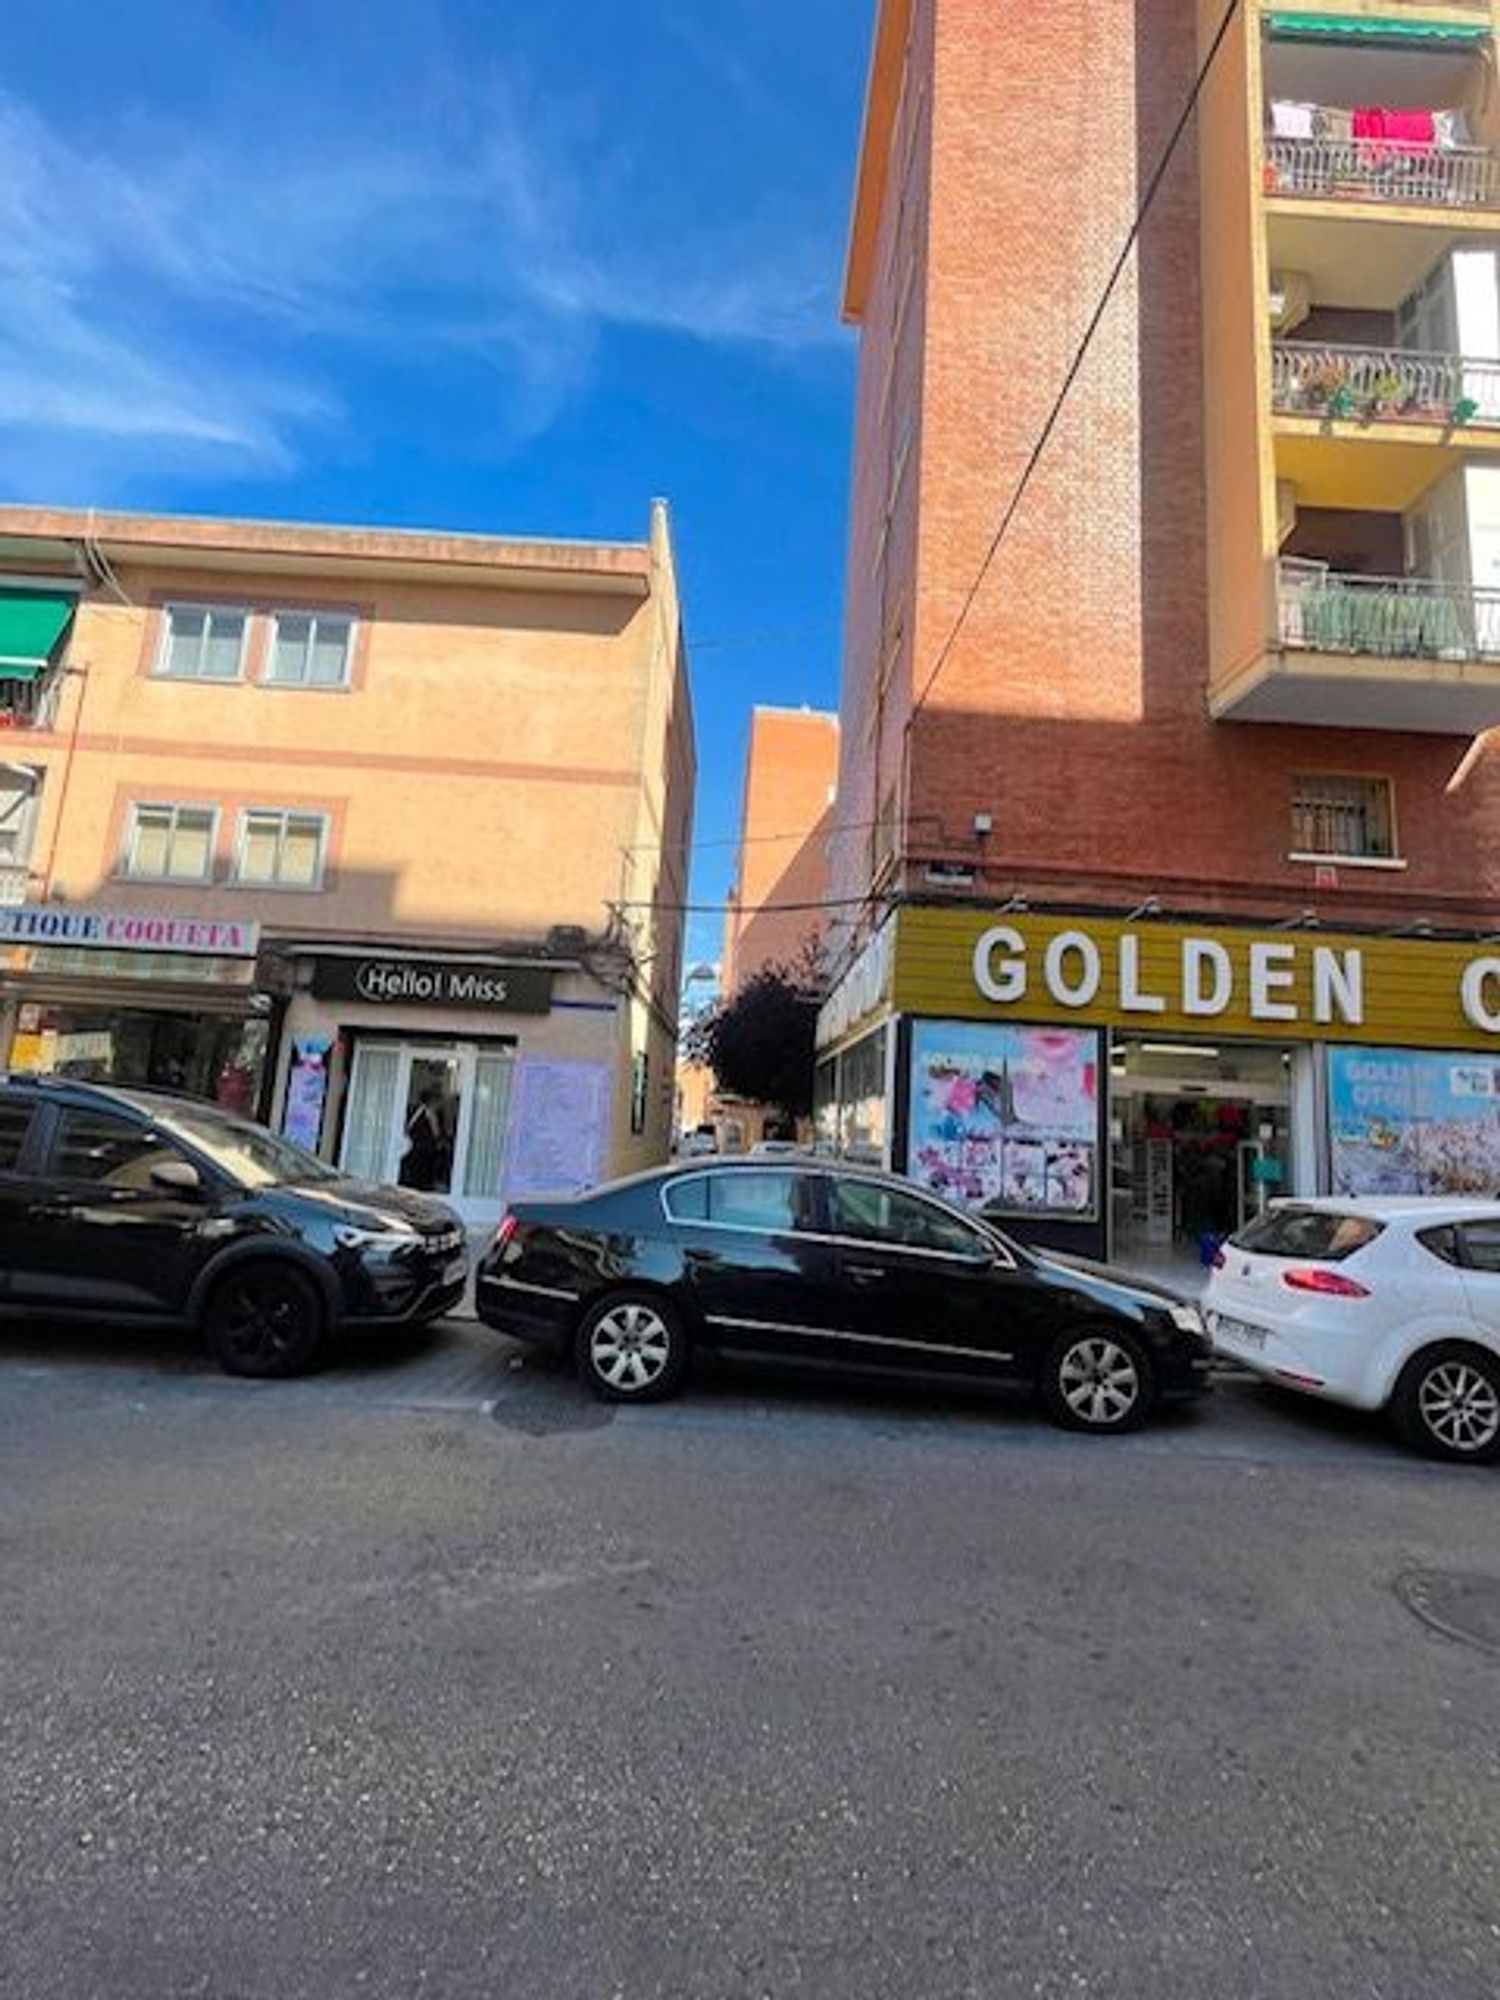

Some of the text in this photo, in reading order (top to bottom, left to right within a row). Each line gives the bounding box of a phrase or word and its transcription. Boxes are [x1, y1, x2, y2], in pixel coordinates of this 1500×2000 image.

[0, 911, 243, 948] TIQUE COQUETA
[367, 966, 507, 1001] Hello! Miss
[972, 925, 1364, 1024] GOLDEN
